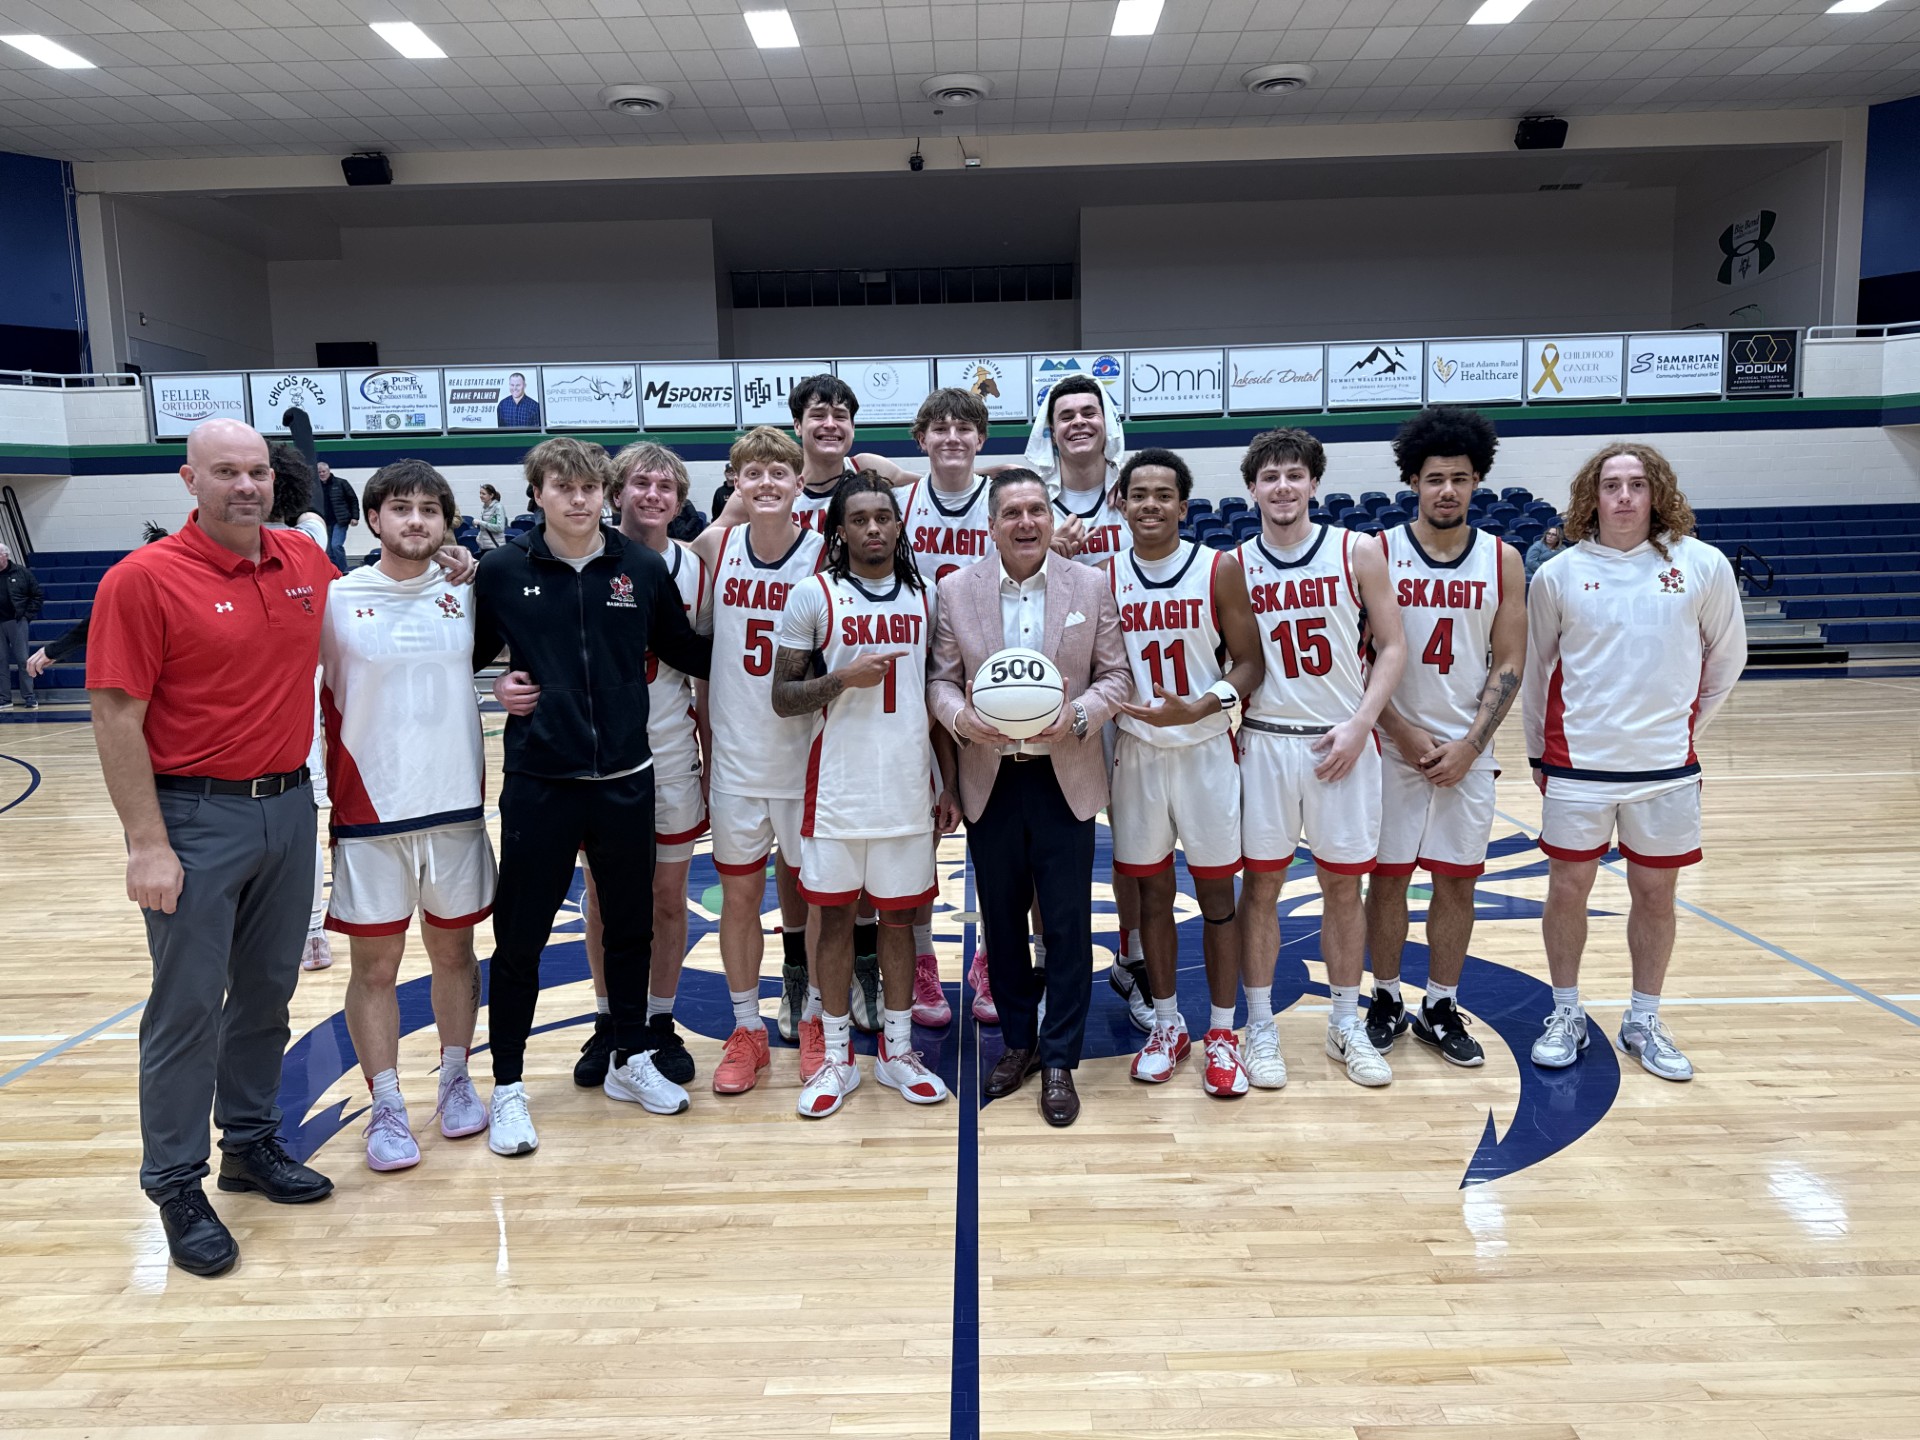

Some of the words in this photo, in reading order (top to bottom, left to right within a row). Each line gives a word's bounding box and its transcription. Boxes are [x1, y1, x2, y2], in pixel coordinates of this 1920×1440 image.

[1476, 360, 1499, 368] Adams
[1500, 359, 1519, 367] Rural
[1563, 350, 1614, 360] CHILDHOOD
[1657, 353, 1720, 364] SAMARITAN
[1231, 363, 1276, 388] Lakeside
[1277, 368, 1323, 384] Dental
[1460, 369, 1519, 381] Healthcare
[1563, 363, 1599, 372] CANCER
[1656, 362, 1719, 371] HEALTHCARE
[1735, 363, 1788, 374] PODIUM
[391, 376, 418, 385] PURE
[464, 378, 485, 386] ESTATE
[485, 378, 504, 386] AGENT
[1131, 361, 1221, 393] Omni
[1562, 374, 1618, 384] AWARENESS
[161, 388, 211, 402] FELLER
[268, 374, 298, 407] CHICO'S
[301, 377, 326, 406] PIZZA
[386, 384, 423, 394] COUNTRY
[452, 392, 472, 400] SHANE
[472, 391, 497, 400] PALMER
[162, 400, 242, 411] ORTHODONTICS
[912, 525, 989, 557] SKAGIT
[723, 577, 796, 612] SKAGI
[1251, 575, 1340, 615] SKAGIT
[1397, 578, 1487, 610] SKAGIT
[1121, 598, 1204, 632] SKAGIT
[841, 613, 923, 647] SKAGIT
[743, 618, 774, 677] 5
[1270, 617, 1333, 679] 15
[1422, 617, 1455, 675] 4
[990, 658, 1046, 684] 500
[1141, 638, 1190, 698] 11
